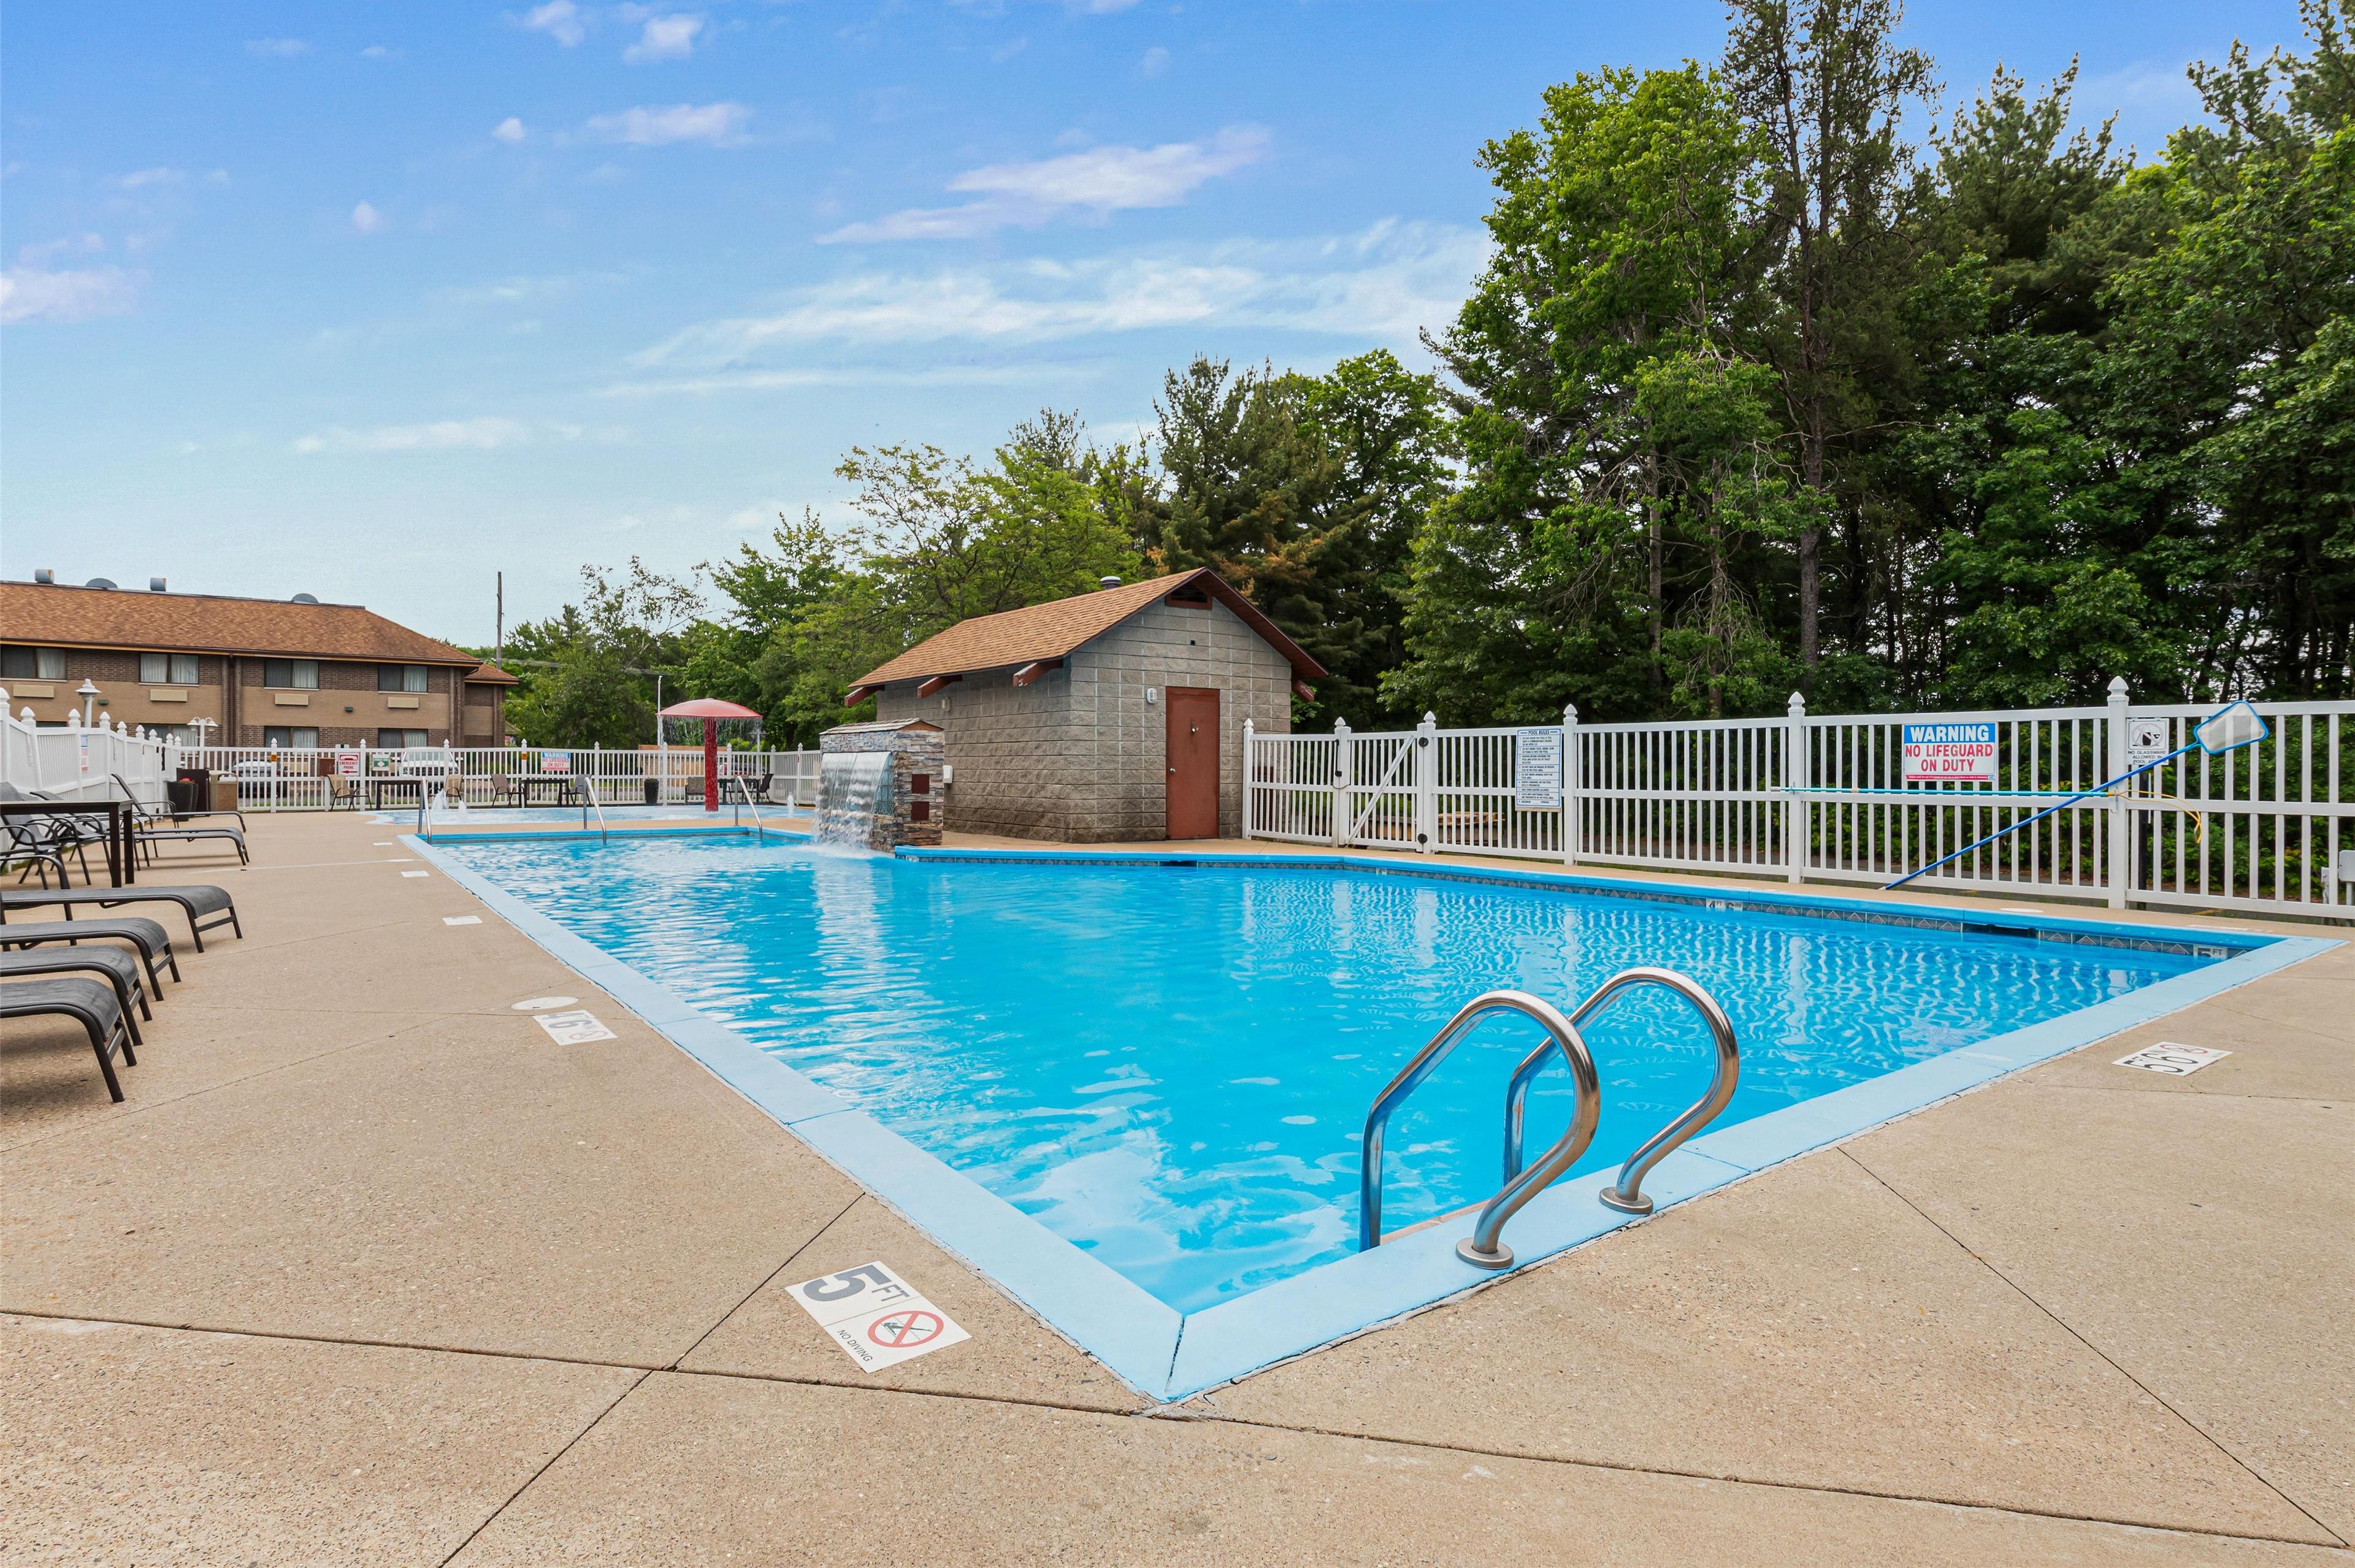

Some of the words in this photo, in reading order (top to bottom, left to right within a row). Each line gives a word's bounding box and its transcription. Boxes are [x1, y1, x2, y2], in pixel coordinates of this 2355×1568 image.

[1910, 725, 1989, 743] WARNING
[1905, 744, 1921, 757] NO
[1926, 744, 1993, 757] LIFEGUARD
[1921, 759, 1937, 772] ON
[1942, 759, 1975, 771] DUTY
[803, 1264, 892, 1302] 5
[871, 1284, 911, 1302] FT
[837, 1329, 851, 1340] NO
[846, 1340, 873, 1363] DIVING
